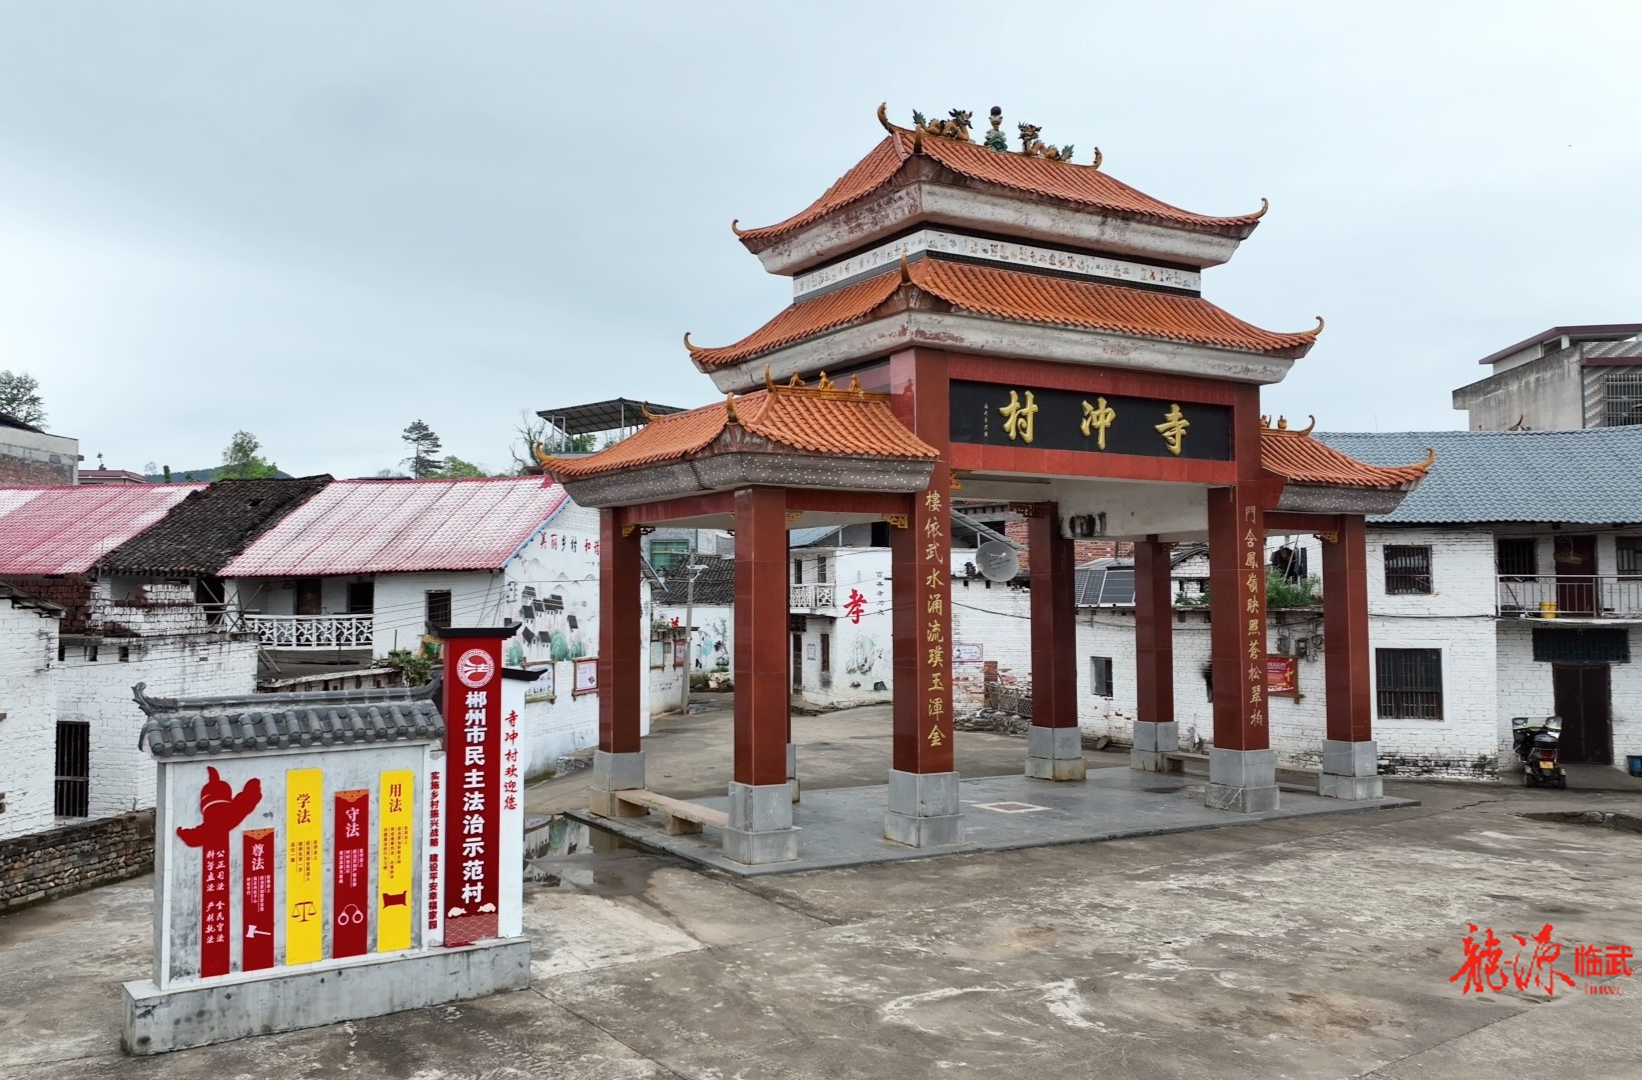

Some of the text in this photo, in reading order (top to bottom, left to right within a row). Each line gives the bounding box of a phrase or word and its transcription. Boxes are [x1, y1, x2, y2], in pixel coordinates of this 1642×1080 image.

[999, 390, 1190, 457] 寺冲村
[843, 588, 867, 624] 孝
[504, 710, 519, 810] 寺冲村欢迎您
[296, 793, 311, 825] 学法
[389, 783, 403, 813] 用法
[461, 691, 487, 904] 郴州市民主法治示范村
[345, 807, 360, 838] 守法
[251, 843, 265, 871] 尊法
[428, 772, 440, 930] 实施乡村振兴战略 建设平安幸福家园
